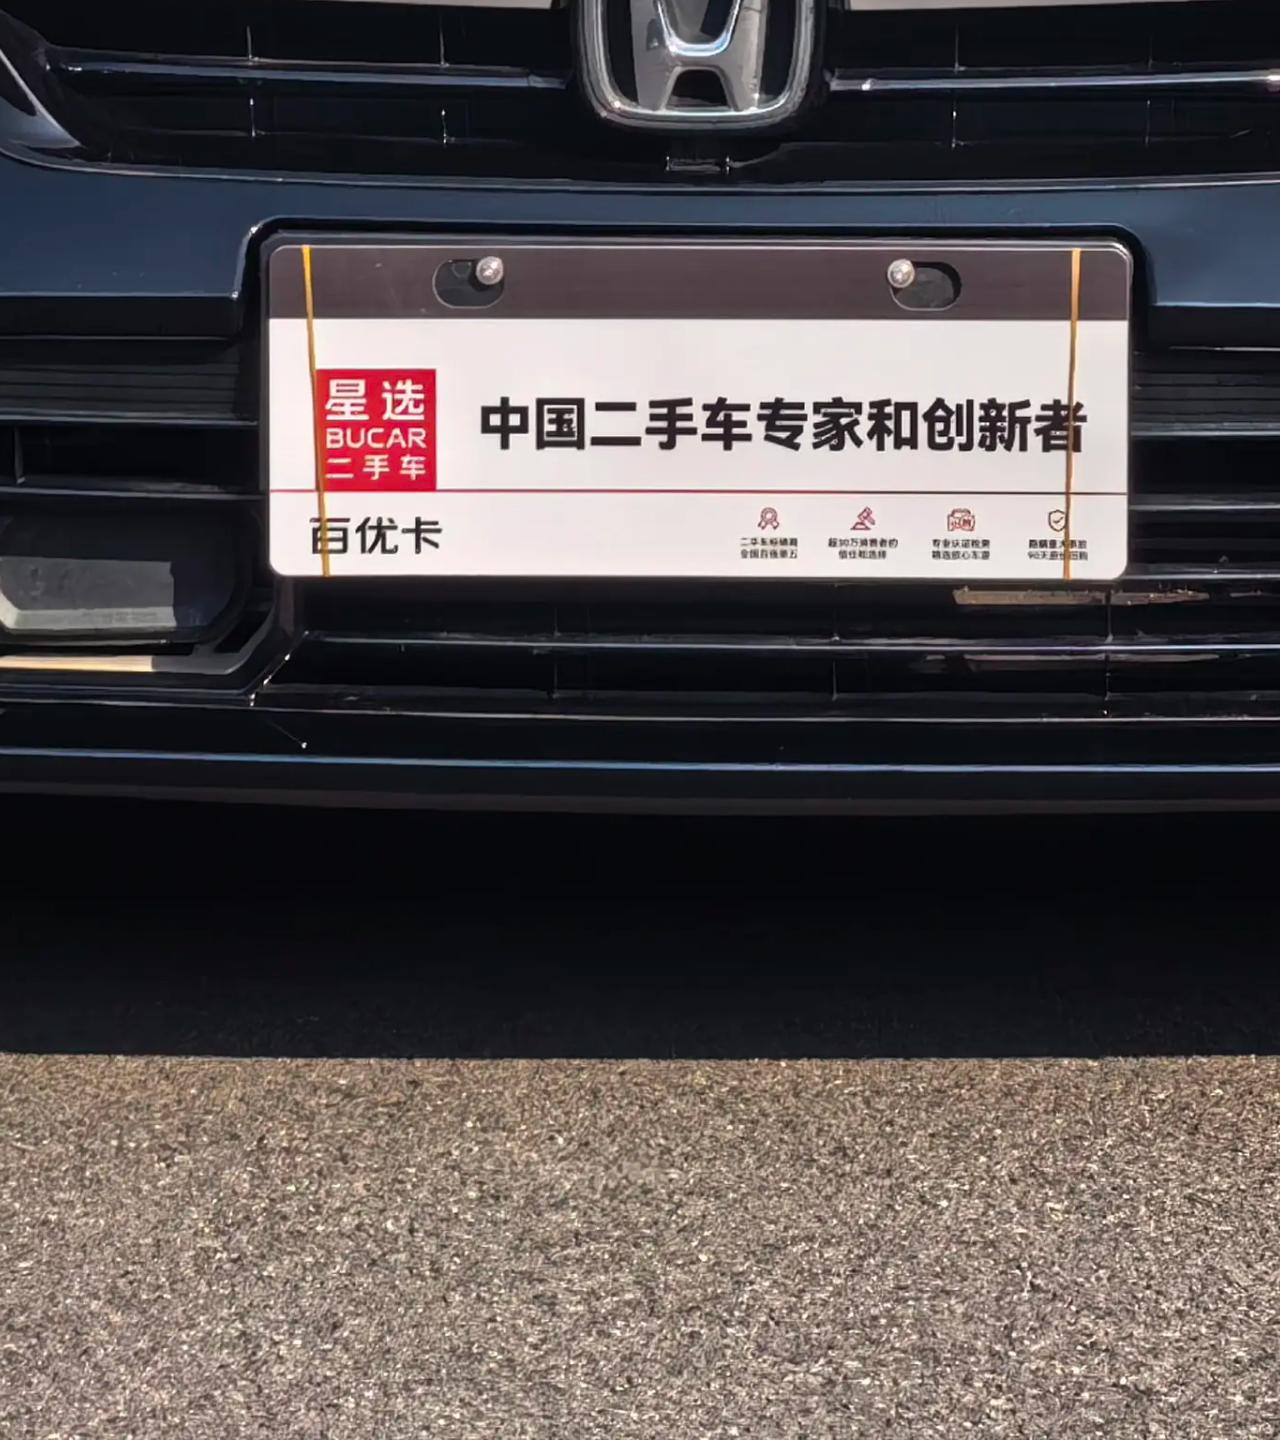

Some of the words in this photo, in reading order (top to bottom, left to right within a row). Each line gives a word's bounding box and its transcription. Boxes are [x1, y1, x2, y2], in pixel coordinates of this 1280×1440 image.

[324, 378, 425, 421] 星选
[325, 427, 427, 449] BUCAR
[479, 396, 1088, 453] 中国二手车专家和创新者
[324, 453, 427, 481] 二手车
[308, 515, 443, 555] 百优卡
